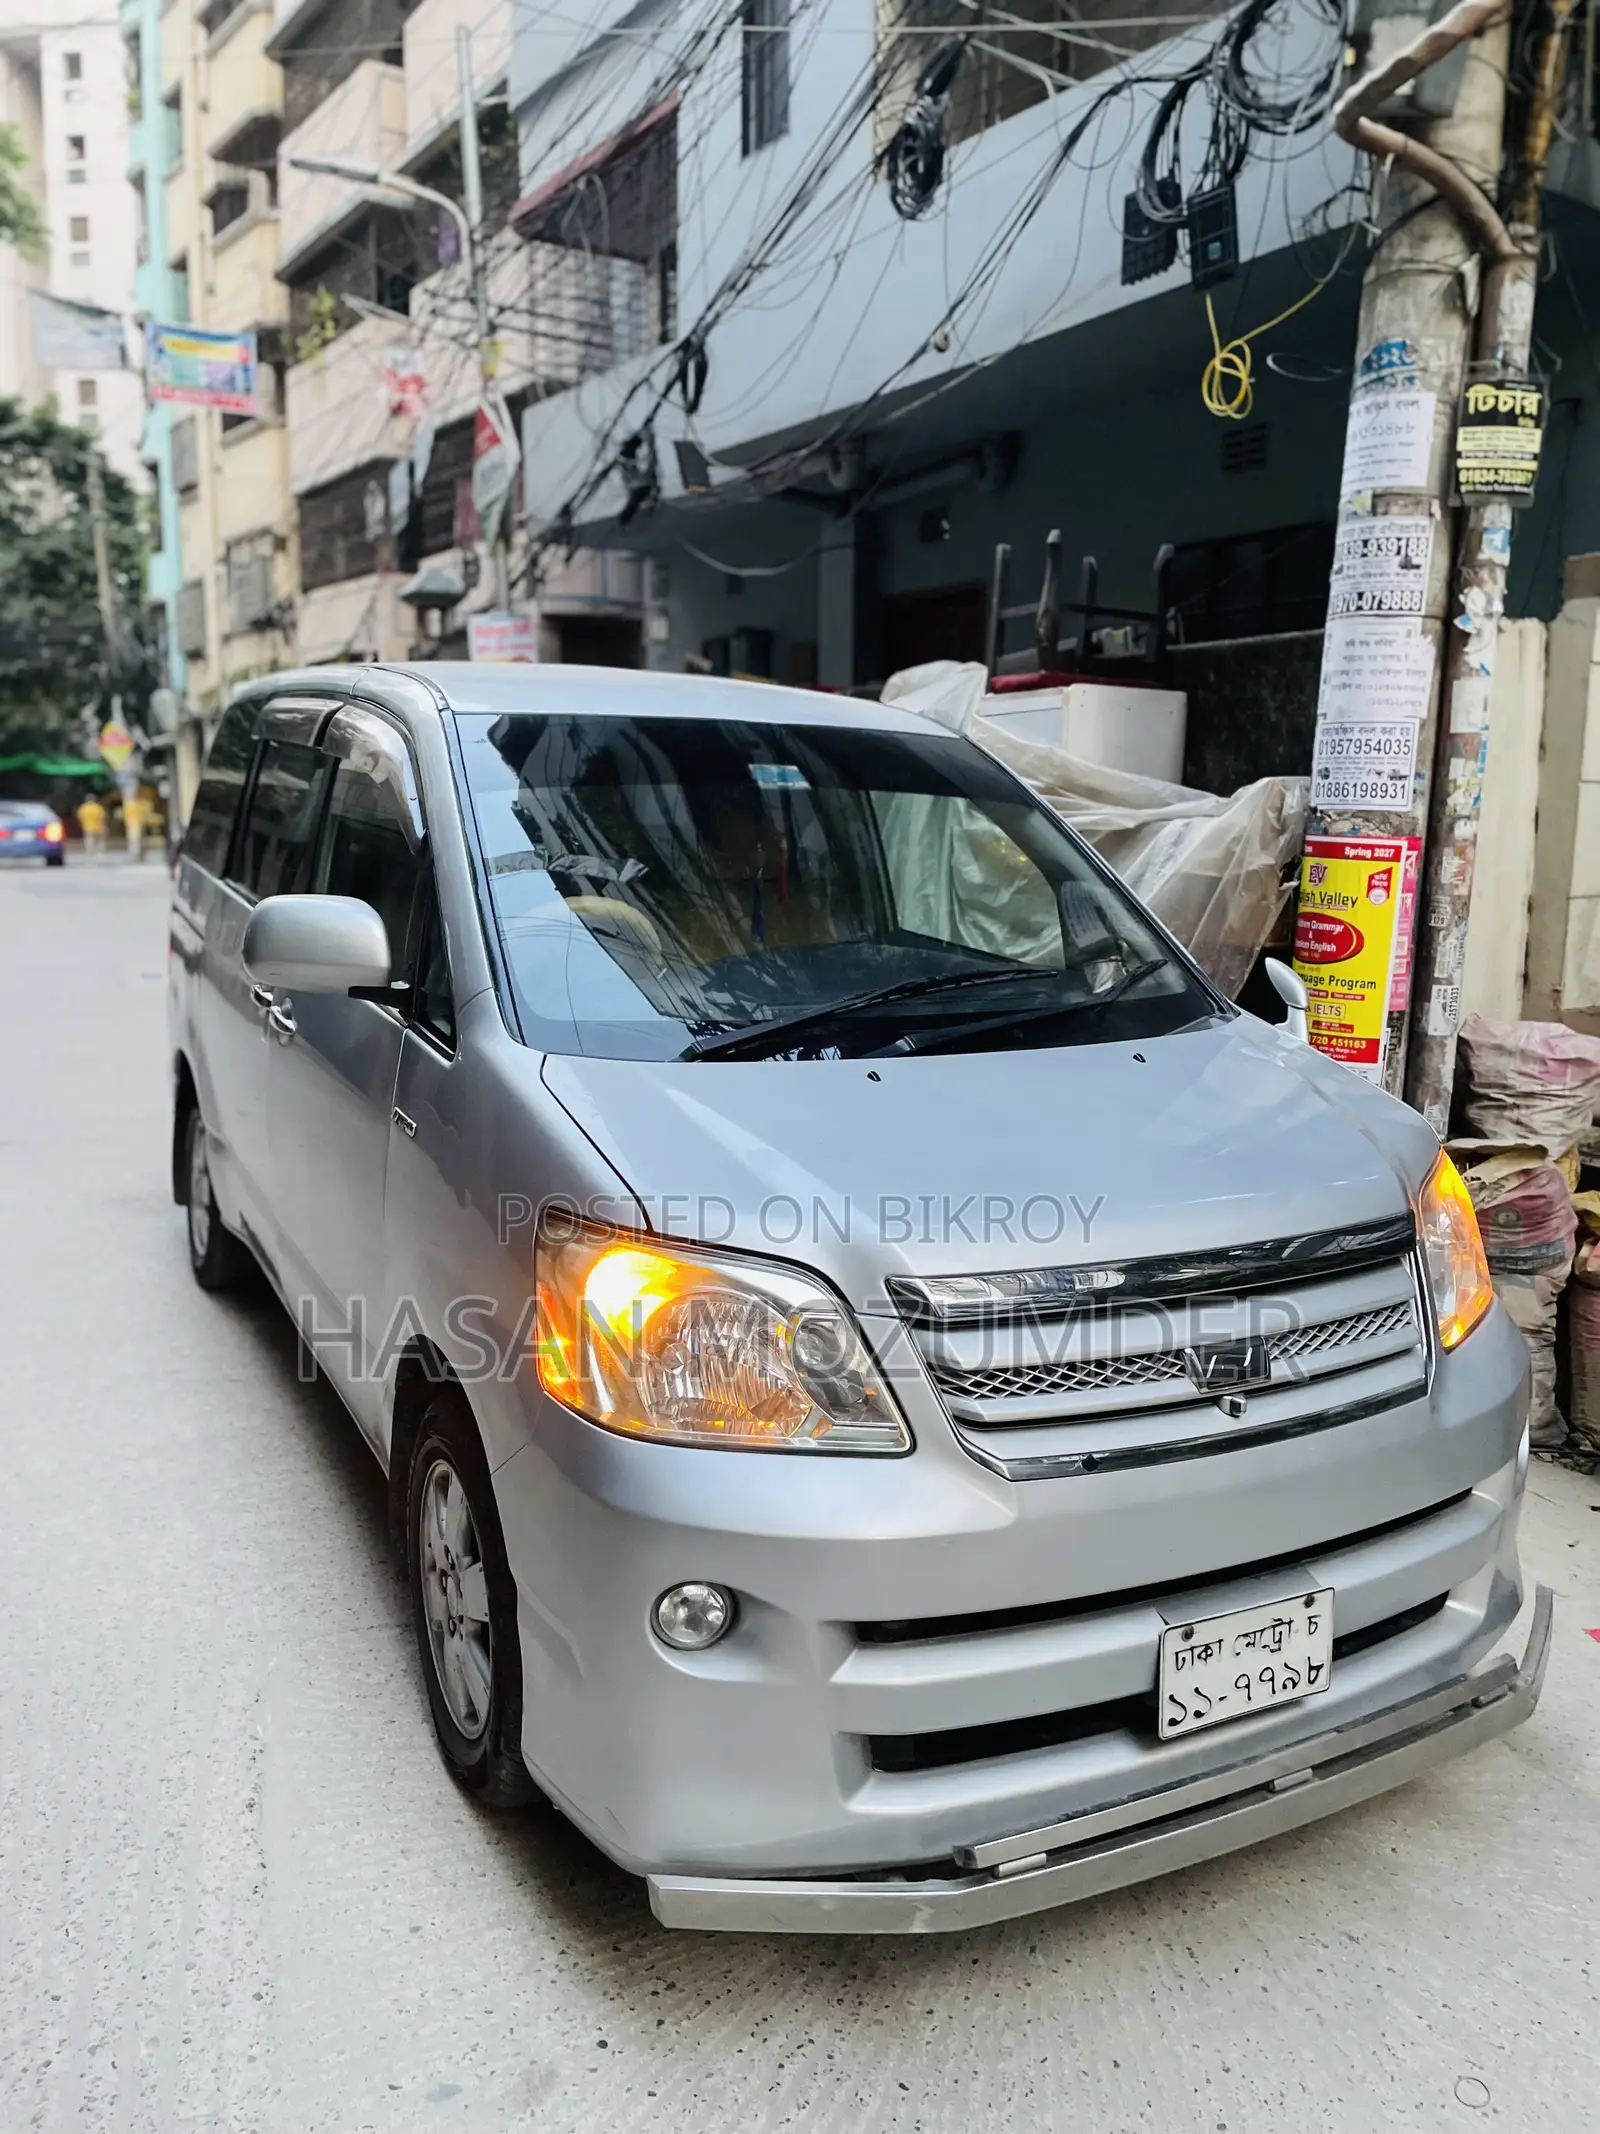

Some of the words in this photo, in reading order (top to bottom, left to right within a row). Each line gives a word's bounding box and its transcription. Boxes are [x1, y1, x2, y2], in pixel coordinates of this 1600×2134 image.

[1318, 738, 1411, 756] 01957954035
[1315, 781, 1406, 799] 01886198931
[1344, 846, 1372, 858] Spring
[1374, 848, 1395, 858] 2027
[1319, 891, 1359, 909] Valley
[1311, 920, 1345, 935] Grammar
[1310, 940, 1337, 953] English
[1328, 975, 1377, 991] Program
[1313, 1003, 1342, 1017] IELTS
[1330, 1037, 1367, 1049] 451163
[1174, 1638, 1224, 1672] ঢাকা
[1233, 1617, 1294, 1656] মেট্রো
[1306, 1614, 1321, 1636] চ
[1167, 1656, 1325, 1727] ১১-৭৭৯৮
